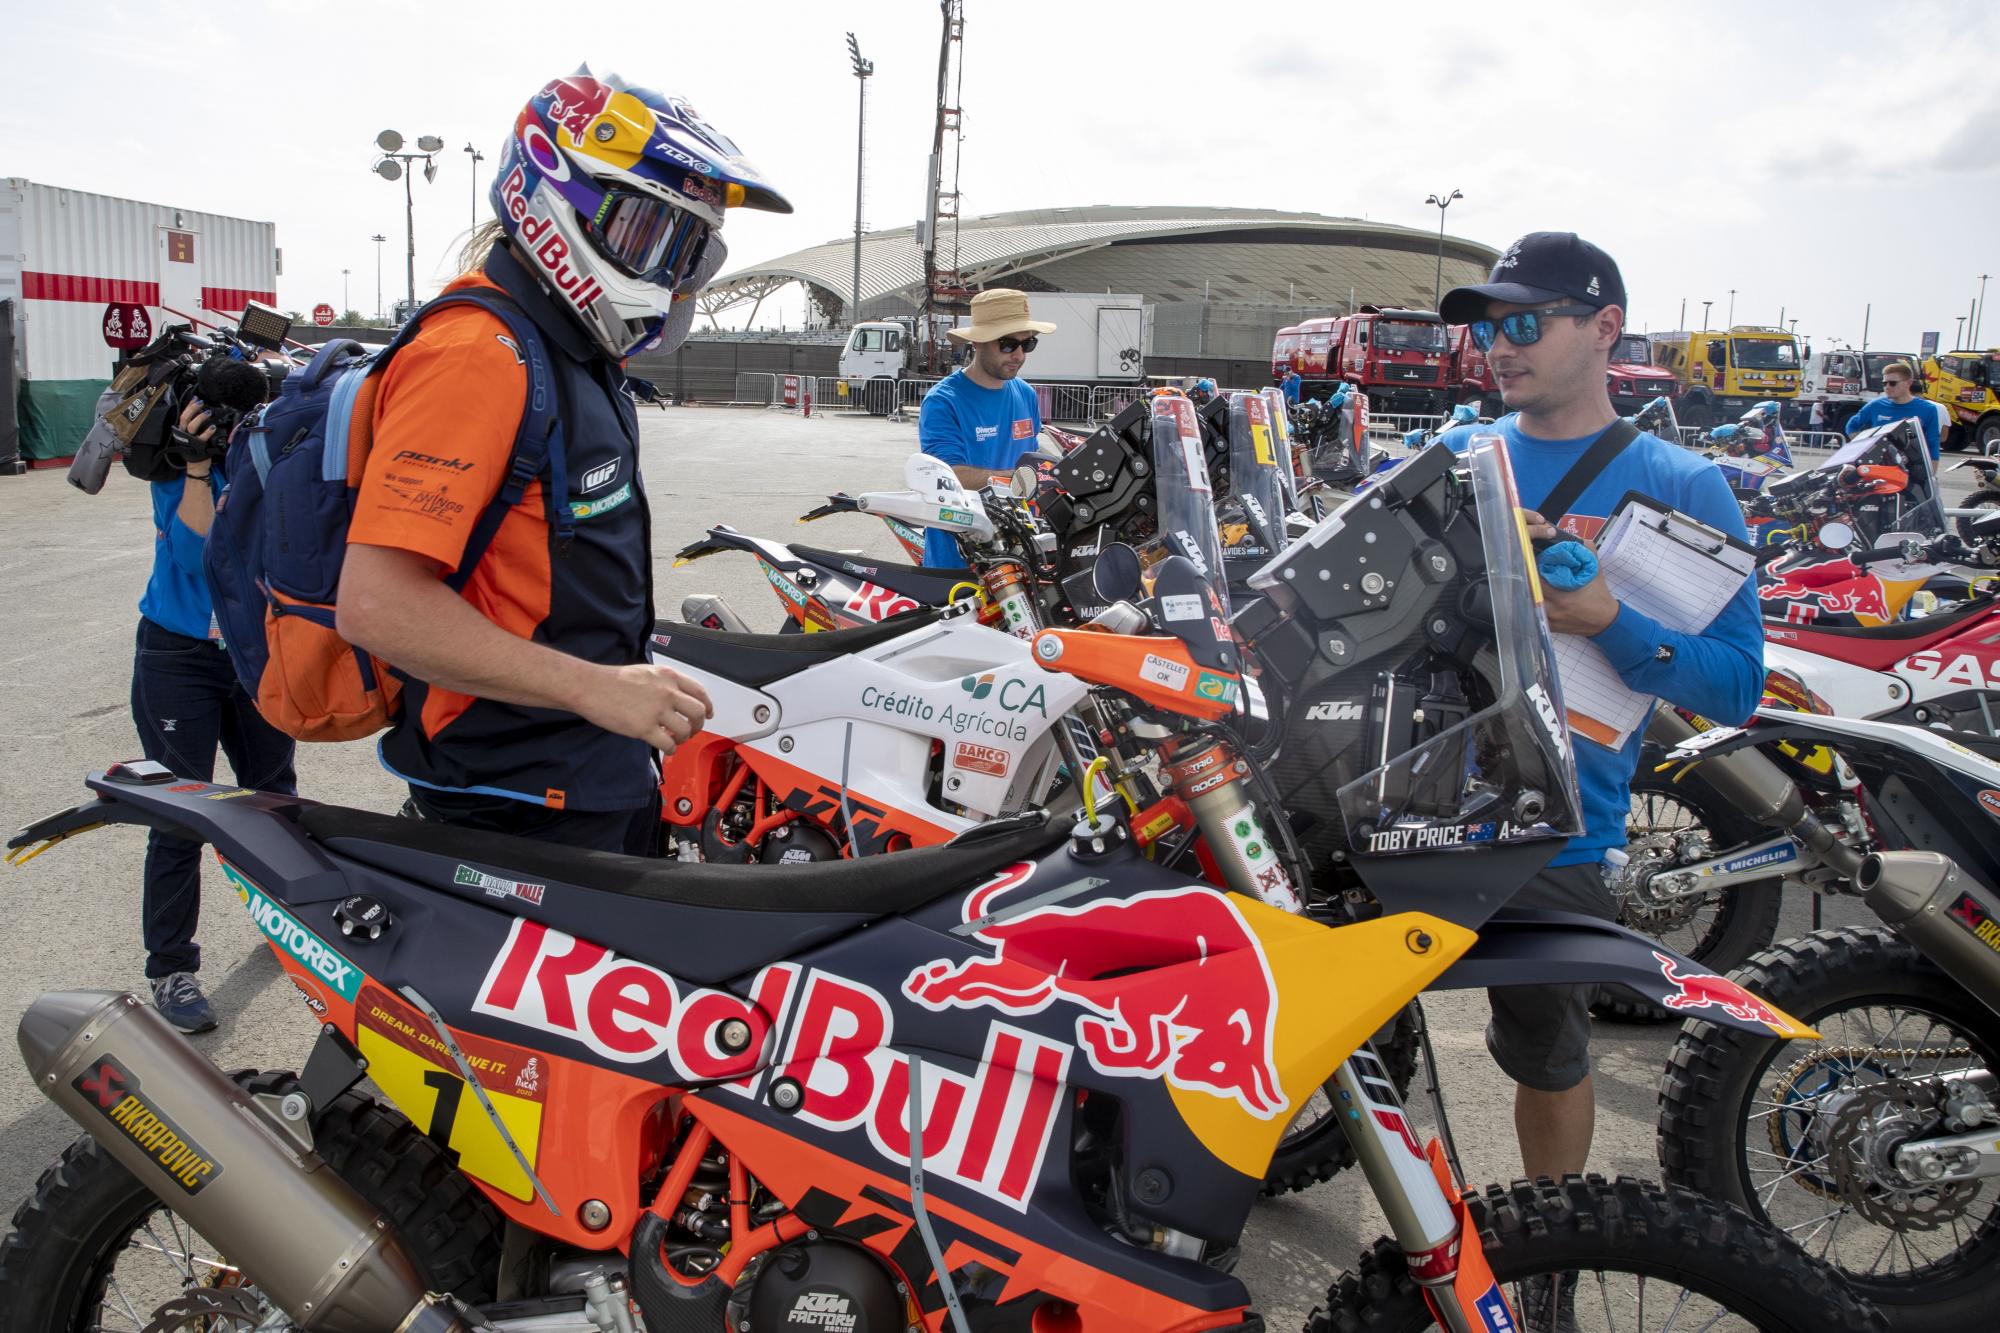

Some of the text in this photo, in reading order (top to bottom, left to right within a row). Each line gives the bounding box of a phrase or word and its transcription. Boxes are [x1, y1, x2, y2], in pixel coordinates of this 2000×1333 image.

[500, 163, 605, 312] Red Bull
[392, 449, 475, 472] pankl
[893, 523, 926, 547] MOTORE
[1174, 530, 1209, 575] KTM
[767, 569, 807, 607] MOTOREX
[842, 580, 921, 624] Re
[1147, 655, 1188, 675] CASTELLET
[1156, 671, 1170, 682] OK
[999, 678, 1048, 720] CA
[1305, 701, 1364, 721] KTM
[861, 686, 1027, 742] Crédito Agrícola
[1525, 682, 1568, 761] KTM
[958, 743, 1006, 763] BAHCO
[1181, 755, 1215, 776] XTRIG
[1191, 772, 1225, 793] ROCS
[1369, 829, 1414, 852] TOBY
[1415, 824, 1465, 848] PRICE
[1730, 849, 1789, 871] MICHELIN
[249, 894, 354, 992] MOTOREX
[370, 1005, 417, 1039] DREAM.
[488, 1061, 506, 1076] IT.
[471, 916, 1075, 1215] Red Bull
[516, 1088, 534, 1097] 2020
[423, 1069, 465, 1168] 1
[914, 1174, 921, 1184] 6
[794, 1291, 850, 1314] KTM
[787, 1309, 857, 1328] FACTORY
